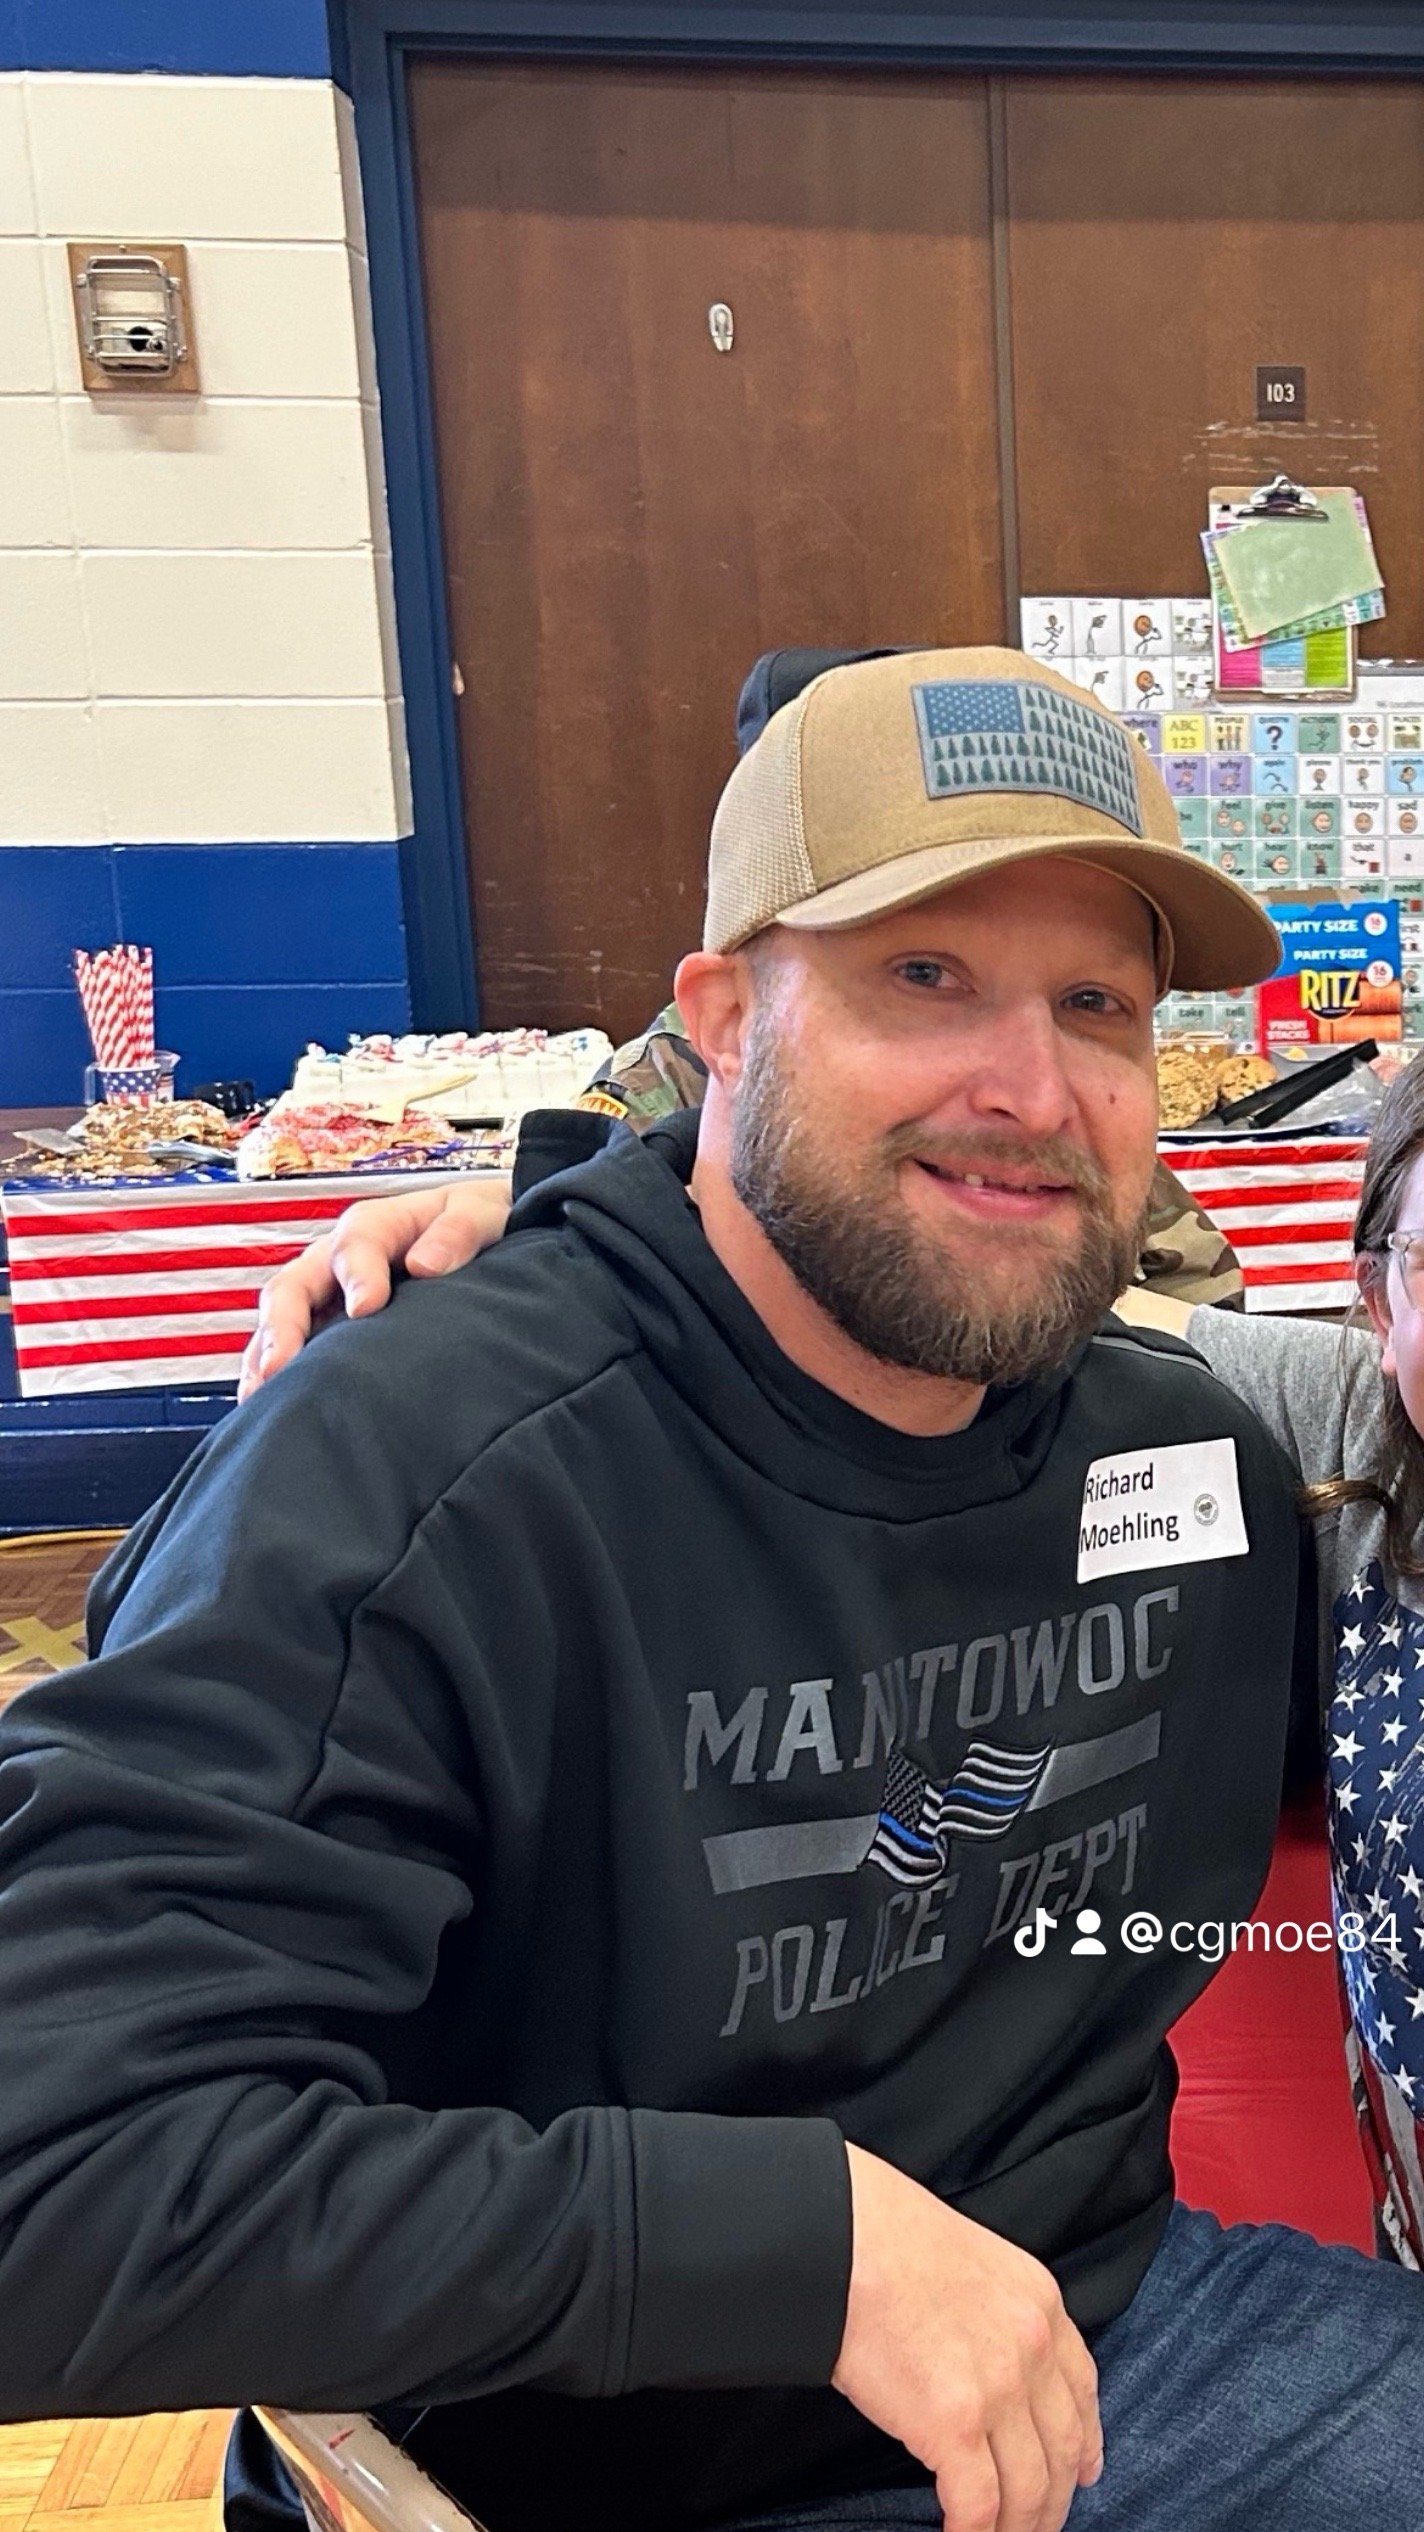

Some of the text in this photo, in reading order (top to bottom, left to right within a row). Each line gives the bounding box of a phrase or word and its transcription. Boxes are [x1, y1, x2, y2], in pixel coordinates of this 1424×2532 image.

[1266, 383, 1295, 402] 103
[1170, 720, 1199, 731] ABC
[1173, 738, 1196, 749] 123
[1173, 760, 1197, 769] who
[1219, 760, 1242, 773] why
[1348, 800, 1379, 811] happy
[1397, 799, 1417, 810] sad
[1275, 919, 1359, 934] PARTY SIZE
[1293, 948, 1368, 961] PARTY SIZE
[1301, 969, 1362, 1011] RITZ
[1267, 1030, 1310, 1040] STACKS
[1084, 1462, 1154, 1504] Richard
[1079, 1512, 1180, 1553] Moehling
[684, 1586, 1179, 1791] MANITOWOC
[983, 1803, 1147, 1948] DEPT
[719, 1872, 960, 2038] POLICE
